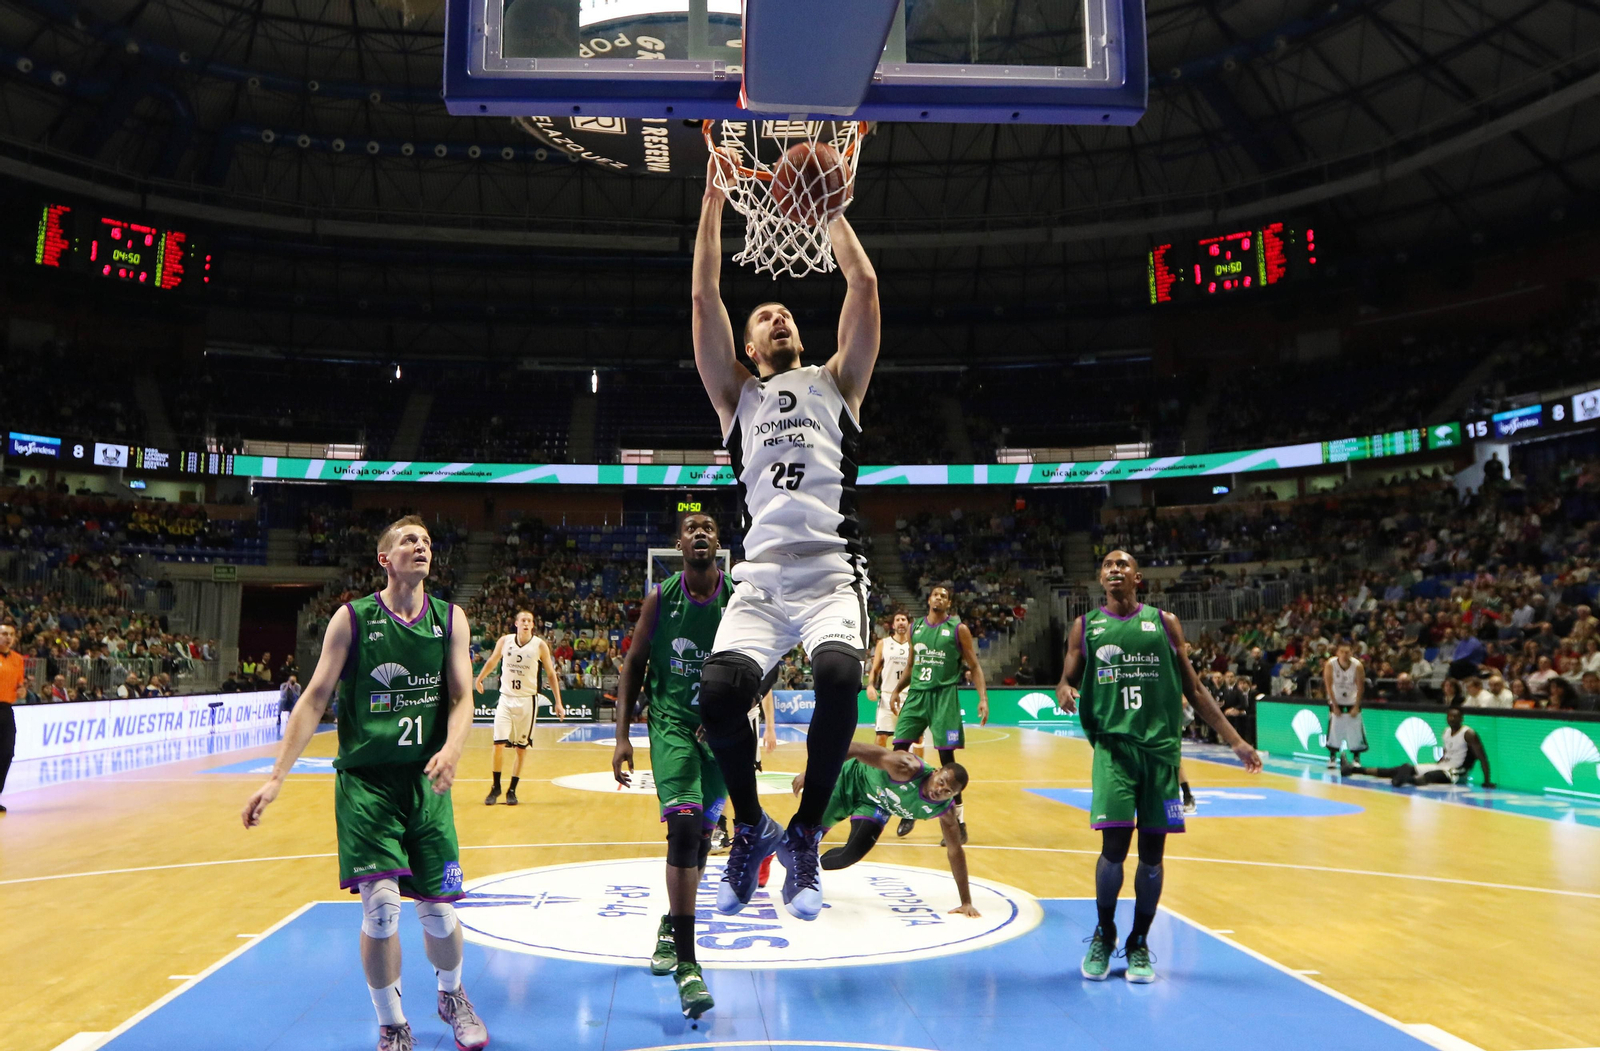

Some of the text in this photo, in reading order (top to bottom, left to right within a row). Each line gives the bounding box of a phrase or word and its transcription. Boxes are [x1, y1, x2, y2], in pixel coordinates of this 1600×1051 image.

[531, 116, 629, 169] ELAZQUEZ
[641, 126, 671, 172] RESERVA
[112, 249, 140, 265] 04:50
[1552, 404, 1565, 421] 8
[1466, 420, 1488, 438] 15
[763, 432, 806, 448] RETA
[73, 444, 84, 458] 8
[334, 465, 369, 477] Unicaja
[371, 468, 390, 476] Obra
[391, 468, 413, 476] Social
[690, 470, 724, 480] Unicaja
[770, 462, 806, 491] 25
[1042, 467, 1078, 479] Unicaja
[1100, 467, 1121, 476] Social
[677, 502, 702, 512] 04:50
[1122, 652, 1160, 664] Unicaja
[920, 667, 932, 681] 23
[511, 679, 522, 690] 13
[691, 682, 702, 706] 2
[1120, 685, 1143, 710] 15
[474, 704, 496, 716] nica
[41, 702, 280, 747] VISITA NUESTRA TIENDA ON-LINE
[398, 715, 423, 746] 21
[597, 884, 651, 918] AP-46
[863, 876, 945, 927] AUTOPISTA
